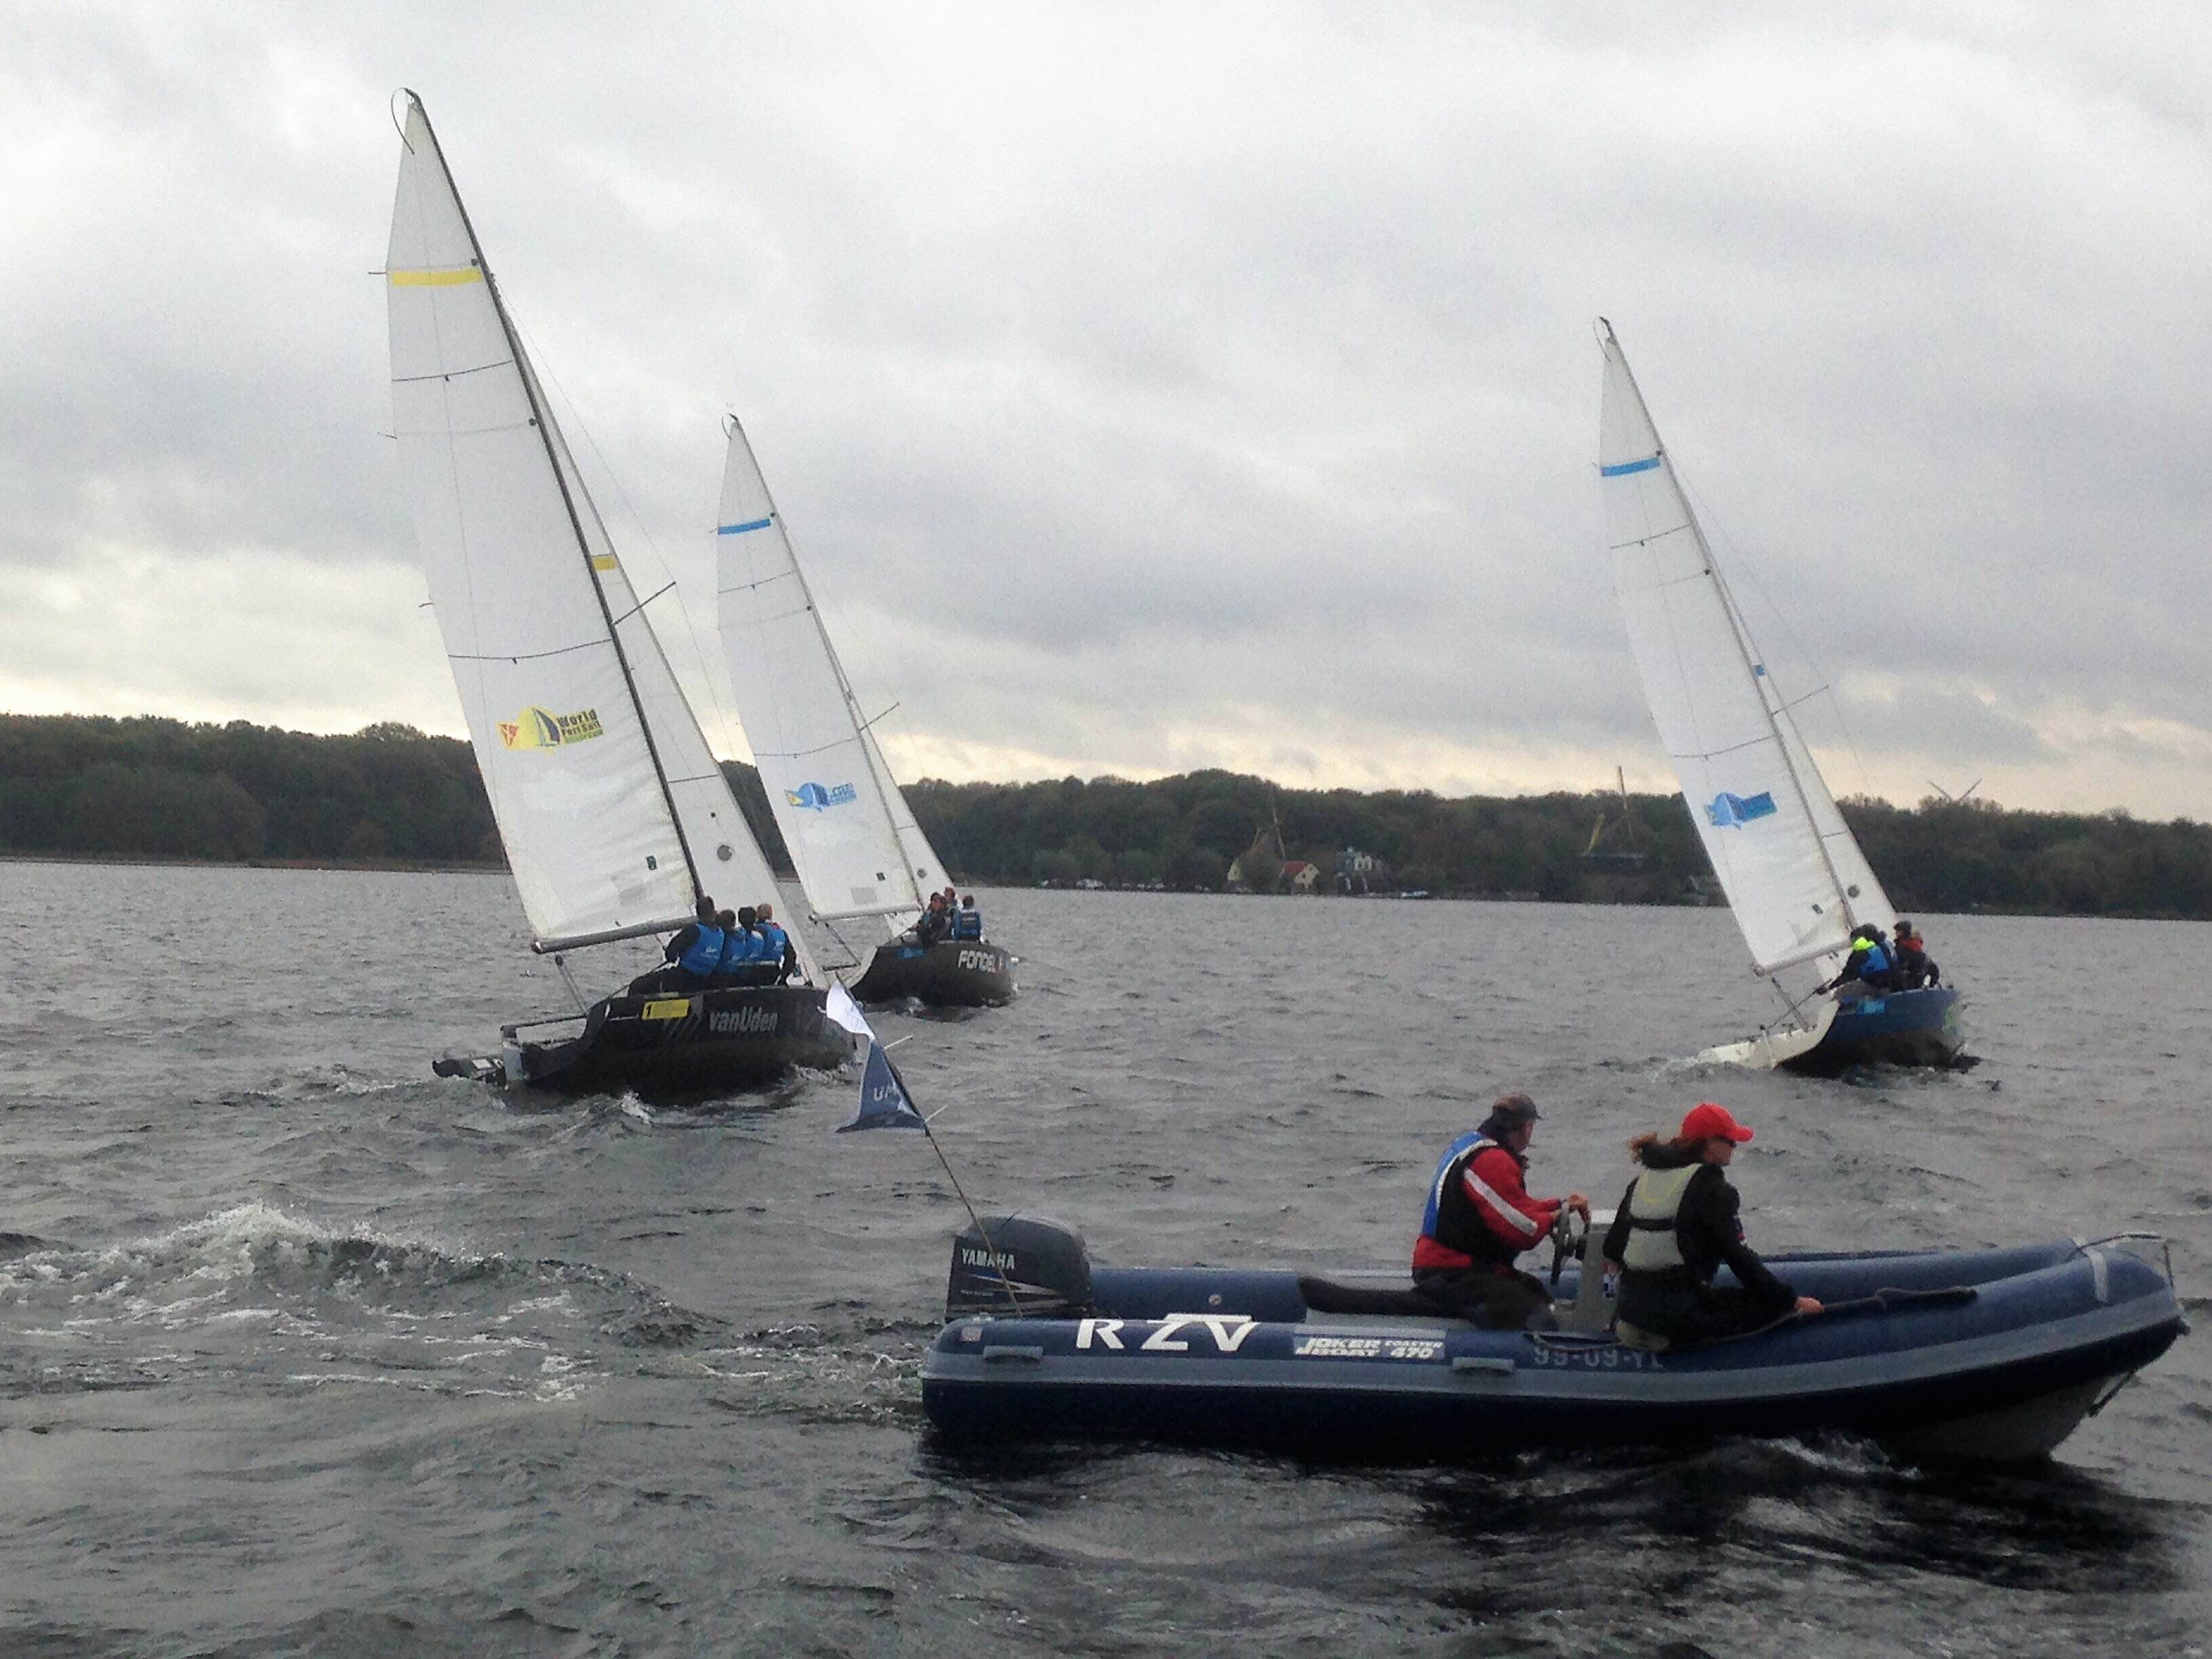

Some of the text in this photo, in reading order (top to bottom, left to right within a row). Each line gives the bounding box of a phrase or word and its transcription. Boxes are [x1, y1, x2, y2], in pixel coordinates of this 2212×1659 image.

[557, 708, 598, 727] World
[645, 1004, 652, 1017] 1
[962, 1248, 1015, 1270] YAMAHA
[1076, 1312, 1260, 1352] RZV
